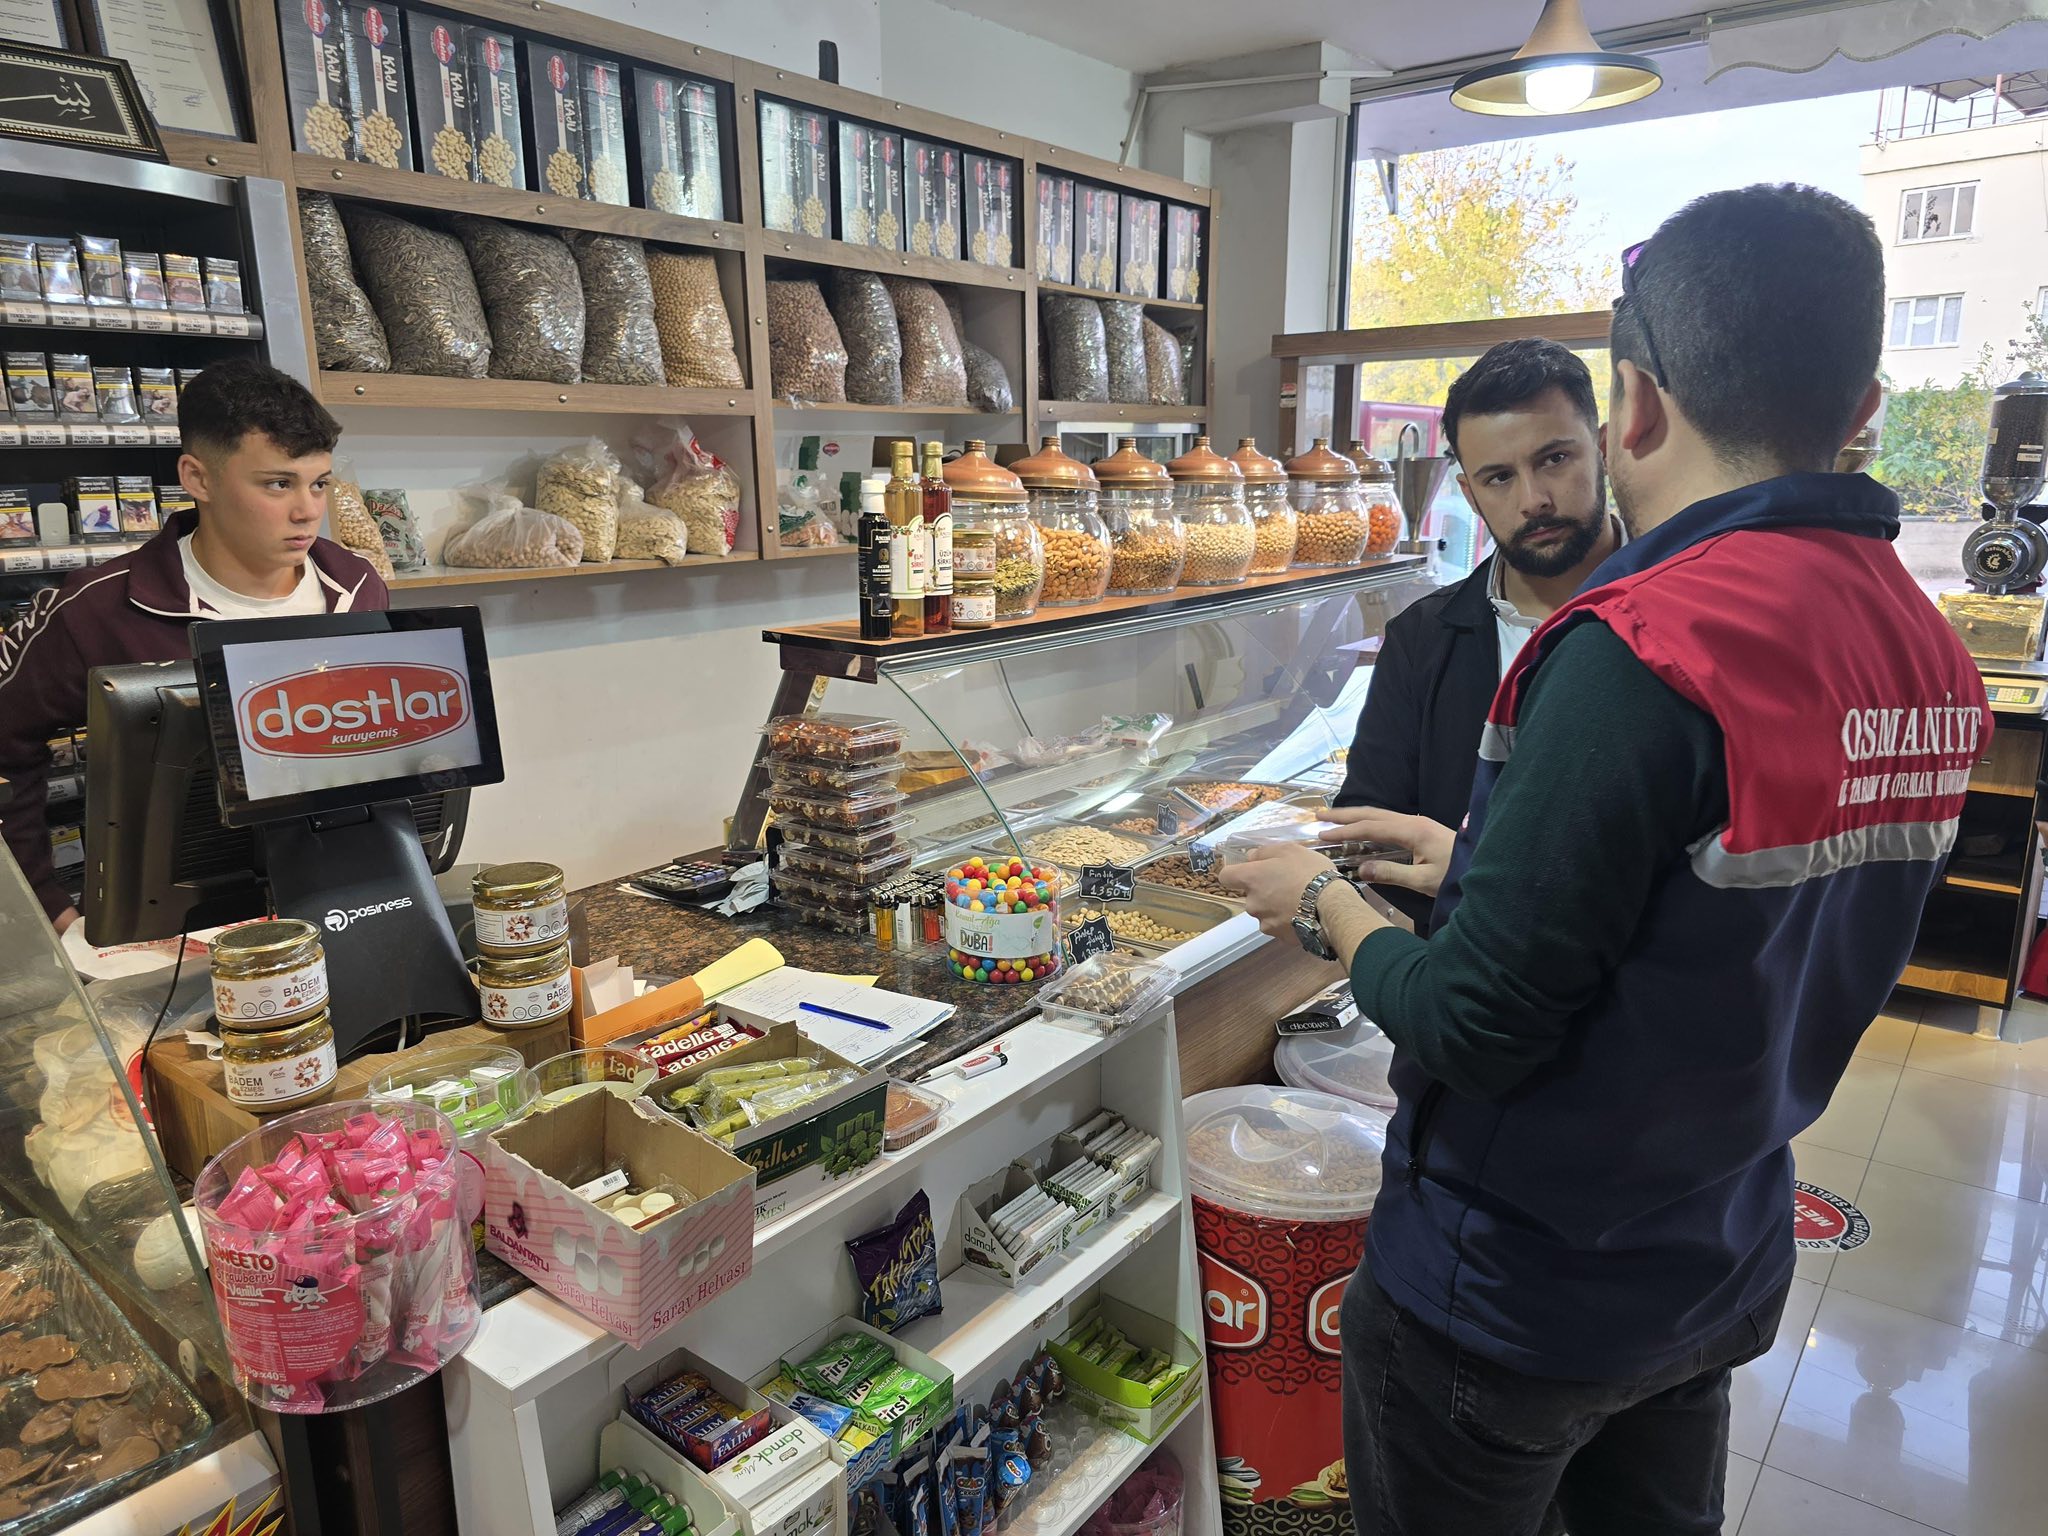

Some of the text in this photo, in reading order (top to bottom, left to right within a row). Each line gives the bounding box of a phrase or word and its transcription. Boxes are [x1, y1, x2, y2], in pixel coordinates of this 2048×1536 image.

[256, 677, 458, 740] dostlar
[331, 726, 399, 751] kuruyemiş
[1890, 771, 1934, 799] ORMAN
[1090, 884, 1121, 897] 1350
[349, 897, 413, 925] posiness
[283, 975, 320, 997] BADEM
[228, 1074, 263, 1087] BADEM
[210, 1240, 275, 1271] SWEETO
[489, 1224, 550, 1273] BALDANTATLI
[964, 1227, 997, 1255] damak
[216, 1267, 276, 1284] Strawberry
[226, 1283, 264, 1298] Vanilla
[652, 1261, 747, 1331] Saray Helvası
[555, 1274, 634, 1338] Saray Helvası
[819, 1342, 883, 1383] First SENSATIONS
[651, 1381, 687, 1405] FALIM
[873, 1364, 904, 1395] SENSATIONS
[901, 1404, 928, 1443] First
[717, 1427, 754, 1458] FALIM
[752, 1427, 804, 1467] damak
